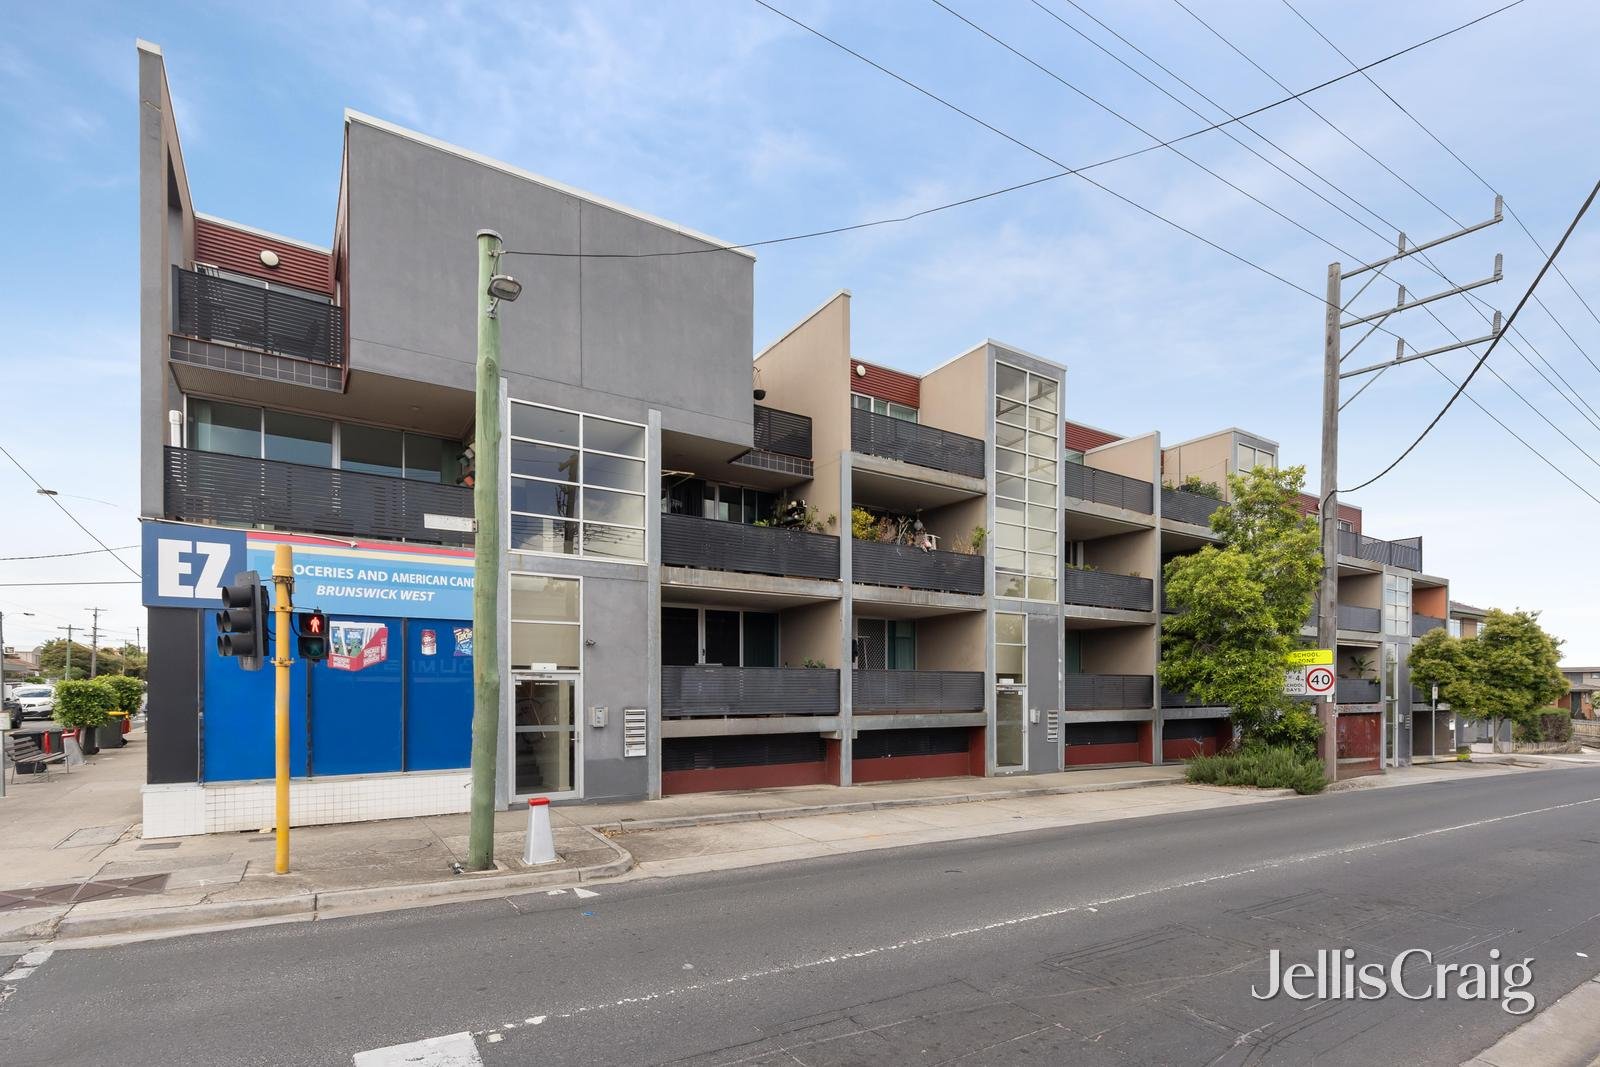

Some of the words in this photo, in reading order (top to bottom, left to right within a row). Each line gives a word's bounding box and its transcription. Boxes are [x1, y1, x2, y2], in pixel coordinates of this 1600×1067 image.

[158, 538, 231, 600] EZ
[272, 564, 354, 580] OCERIES
[357, 569, 389, 582] AND
[392, 572, 448, 586] AMERICAN
[316, 585, 398, 600] BRUNSWICK
[400, 589, 436, 602] WEST
[1311, 675, 1330, 685] 40
